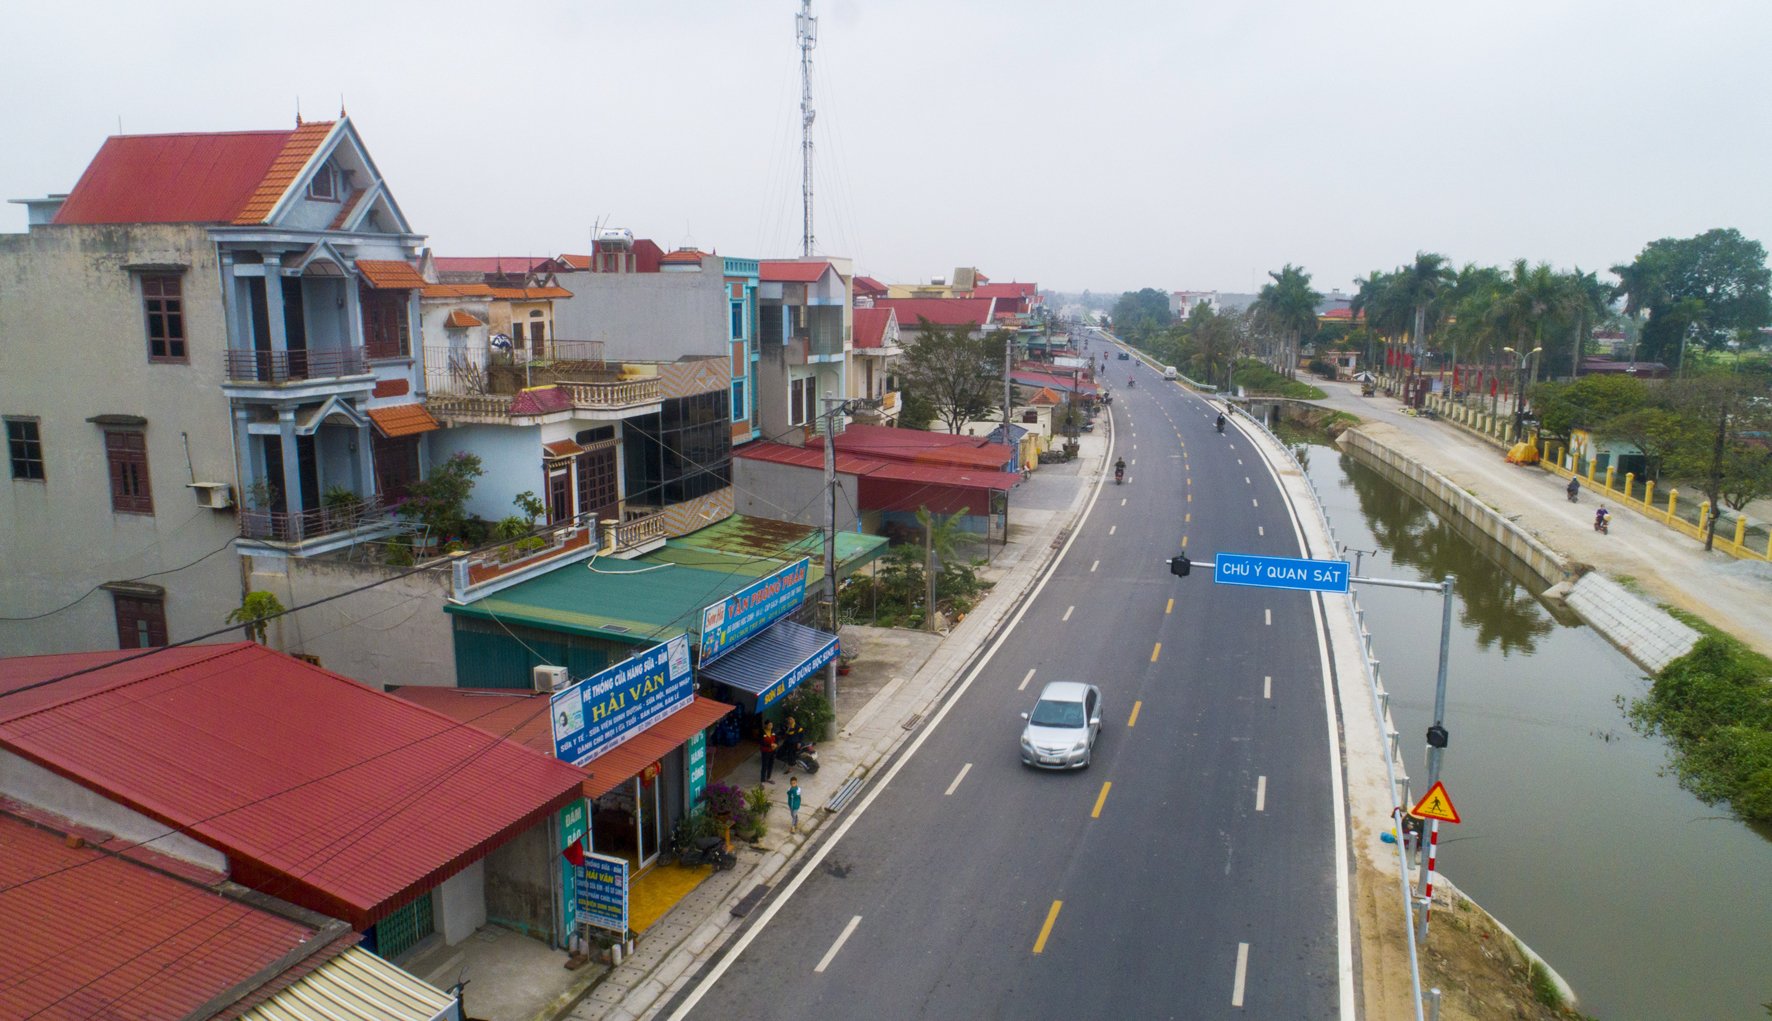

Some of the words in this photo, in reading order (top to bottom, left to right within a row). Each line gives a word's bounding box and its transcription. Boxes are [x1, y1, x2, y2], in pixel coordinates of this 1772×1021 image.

[1222, 561, 1250, 576] CHÚ
[1254, 562, 1262, 576] Ý
[1267, 566, 1307, 580] QUAN
[1314, 566, 1341, 582] SÁT
[583, 685, 592, 704] HỆ
[592, 677, 614, 696] THỐNG
[592, 692, 626, 722] HẢI
[629, 672, 665, 702] VÂN
